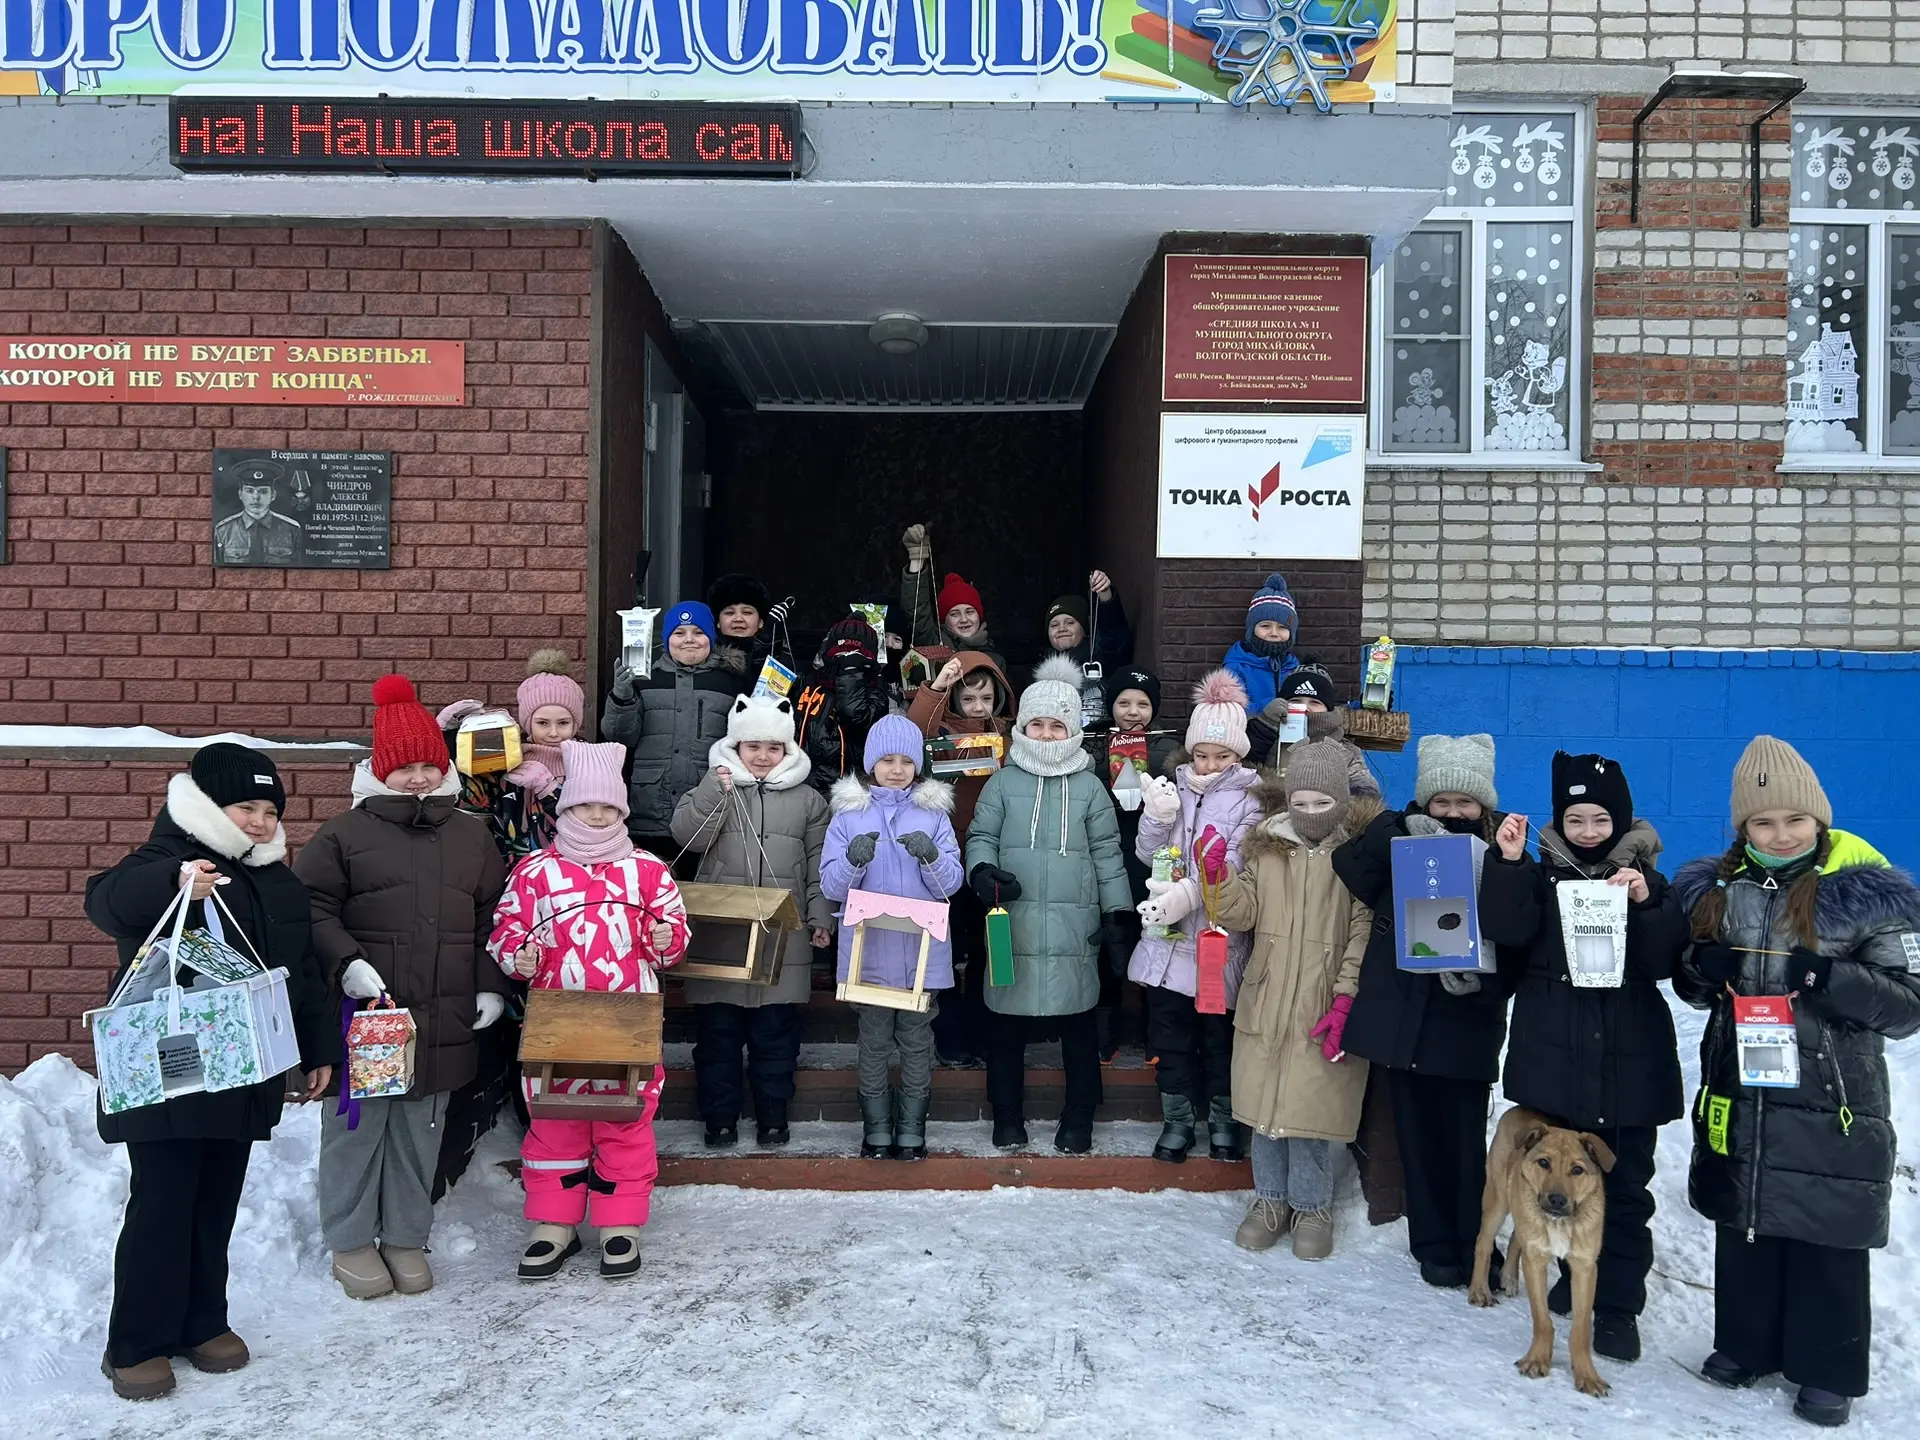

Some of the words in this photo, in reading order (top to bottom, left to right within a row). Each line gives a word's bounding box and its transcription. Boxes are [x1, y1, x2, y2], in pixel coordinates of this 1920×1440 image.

[179, 104, 265, 154] на!
[291, 105, 460, 156] Наша
[484, 120, 671, 159] школа
[1193, 263, 1251, 272] Администрация
[1211, 272, 1257, 280] Михайловка
[1258, 273, 1312, 281] Волгоградской
[1210, 291, 1282, 302] Муниципальное
[1283, 293, 1323, 301] казенное
[1192, 302, 1287, 312] общеобразовательное
[1288, 304, 1340, 313] учреждение
[1208, 320, 1258, 330] «СРЕДНЯЯ
[1260, 320, 1297, 329] ШКОЛА
[1299, 321, 1309, 329] №
[1311, 321, 1320, 329] 11
[1195, 330, 1293, 340] МУНИЦИПАЛЬНОГО
[1295, 331, 1333, 340] ОКРУГА
[1212, 341, 1244, 351] ГОРОД
[1245, 340, 1315, 350] МИХАЙЛОВКА
[9, 342, 132, 360] КОТОРОЙ
[144, 345, 179, 361] НЕ
[191, 345, 275, 364] БУДЕТ
[287, 346, 432, 364] ЗАБВЕНЬЯ.
[1195, 350, 1279, 362] ВОЛГОГРАДСКОЙ
[1280, 352, 1332, 361] ОБЛАСТИ»
[129, 371, 163, 387] НЕ
[175, 371, 260, 391] БУДЕТ
[347, 393, 356, 402] Р.
[1204, 428, 1224, 436] Центр
[1225, 427, 1267, 435] образования
[1174, 437, 1210, 445] цифрового
[1265, 437, 1298, 445] профилей
[271, 450, 277, 459] В
[327, 482, 372, 491] ЧИНДРОВ
[330, 492, 368, 501] АЛЕКСЕЙ
[1169, 488, 1242, 505] ТОЧКА
[1280, 490, 1351, 506] РОСТА
[316, 503, 383, 511] ВЛАДИМИРОВИЧ
[1574, 925, 1613, 935] МОЛОКО
[1744, 1015, 1780, 1023] МОЛОКО
